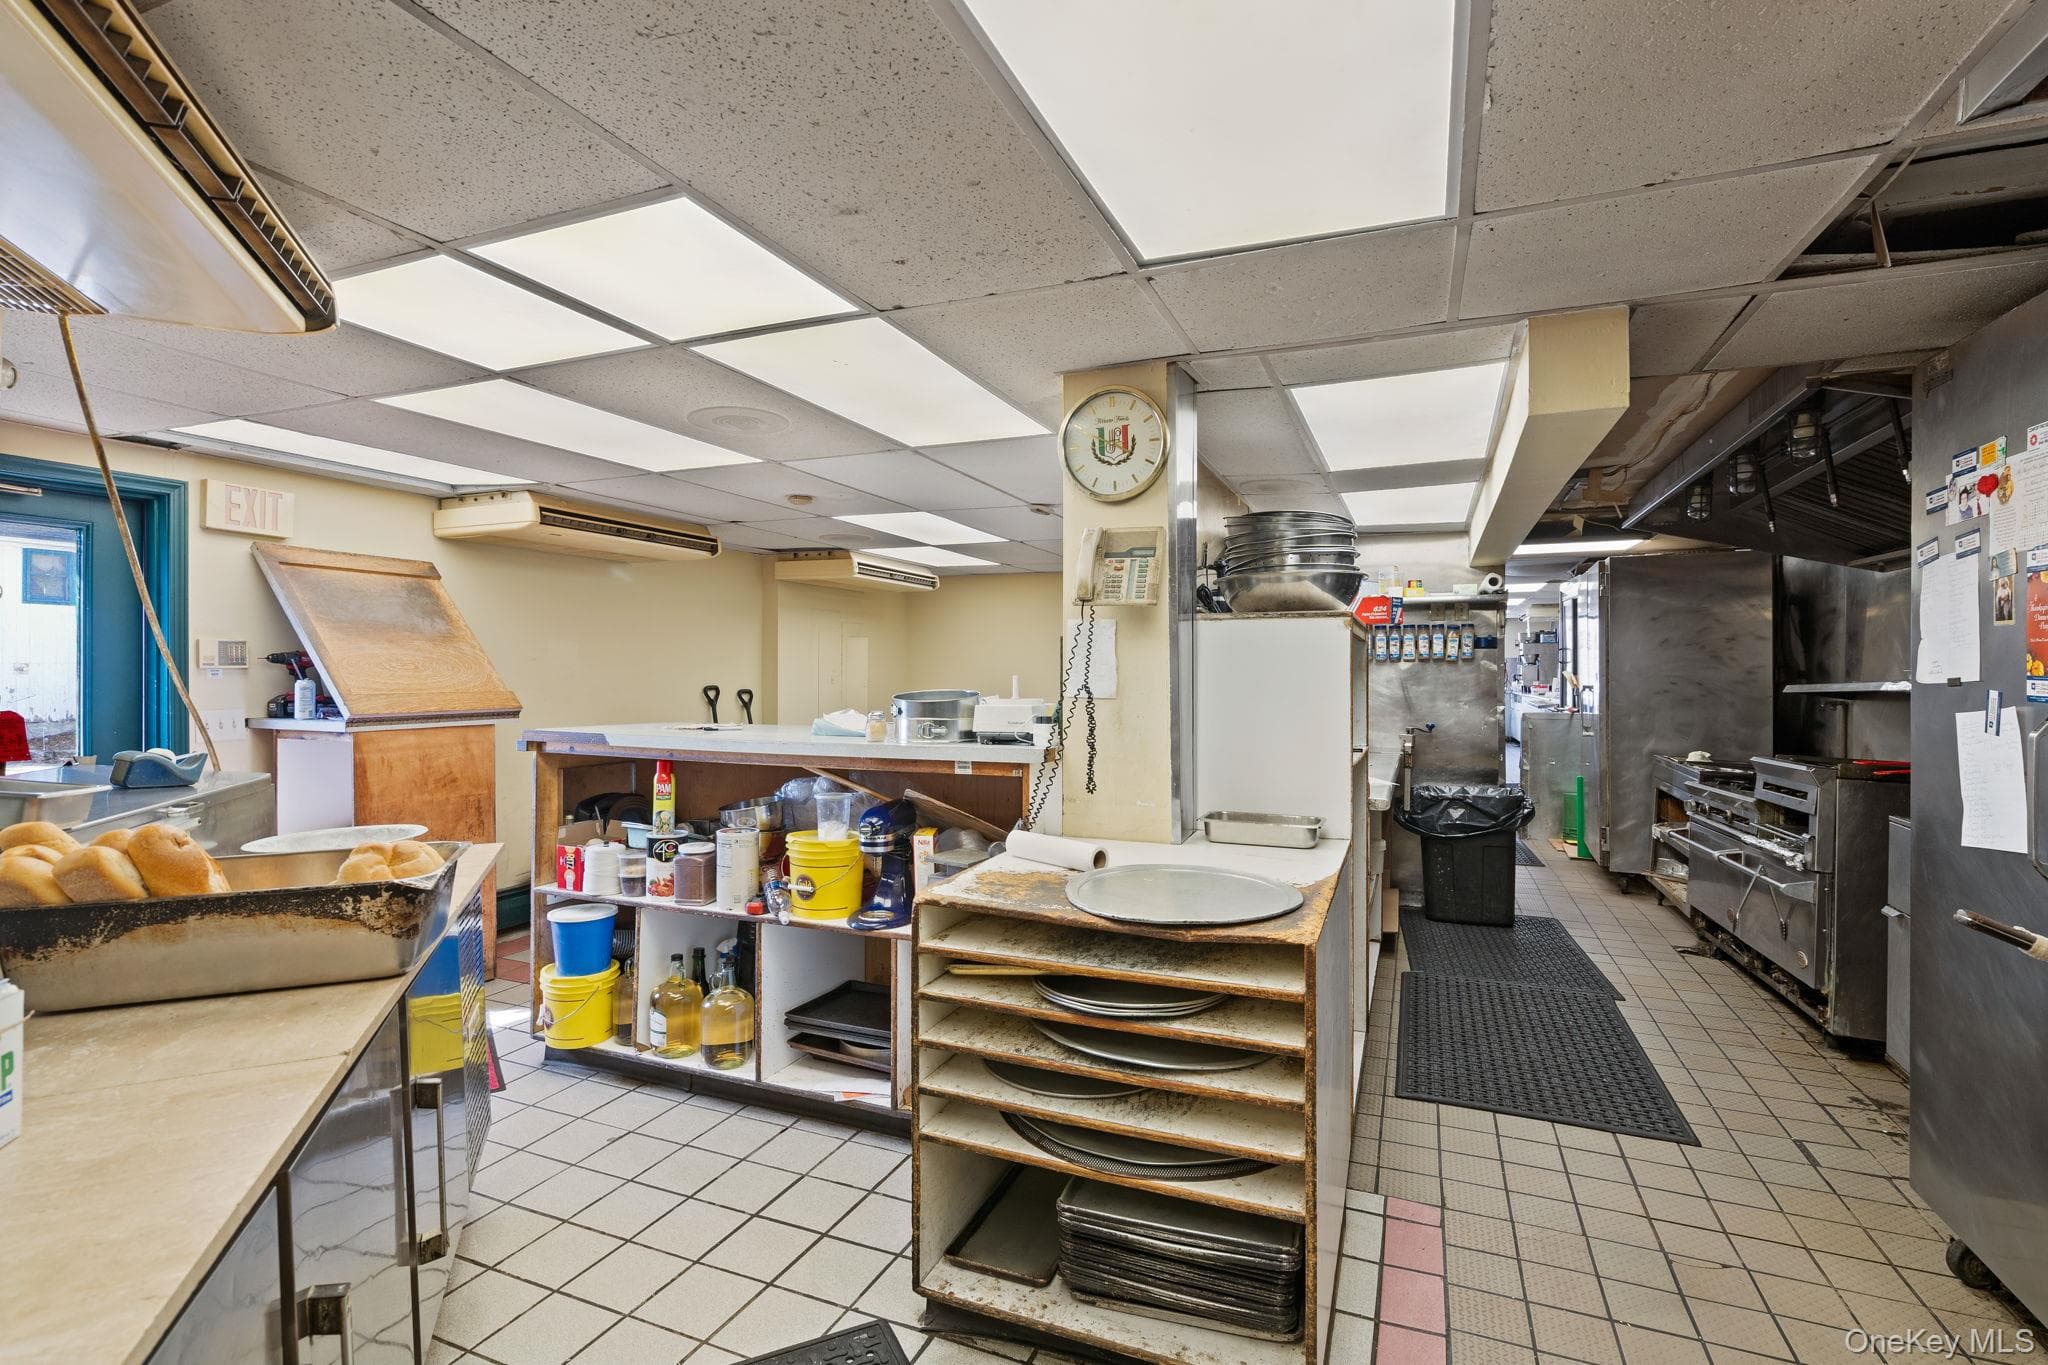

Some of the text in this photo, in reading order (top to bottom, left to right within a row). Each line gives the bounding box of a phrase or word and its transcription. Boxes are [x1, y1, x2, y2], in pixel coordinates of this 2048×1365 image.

[224, 484, 283, 532] EXIT
[656, 783, 671, 794] PAM
[656, 842, 676, 861] 4C
